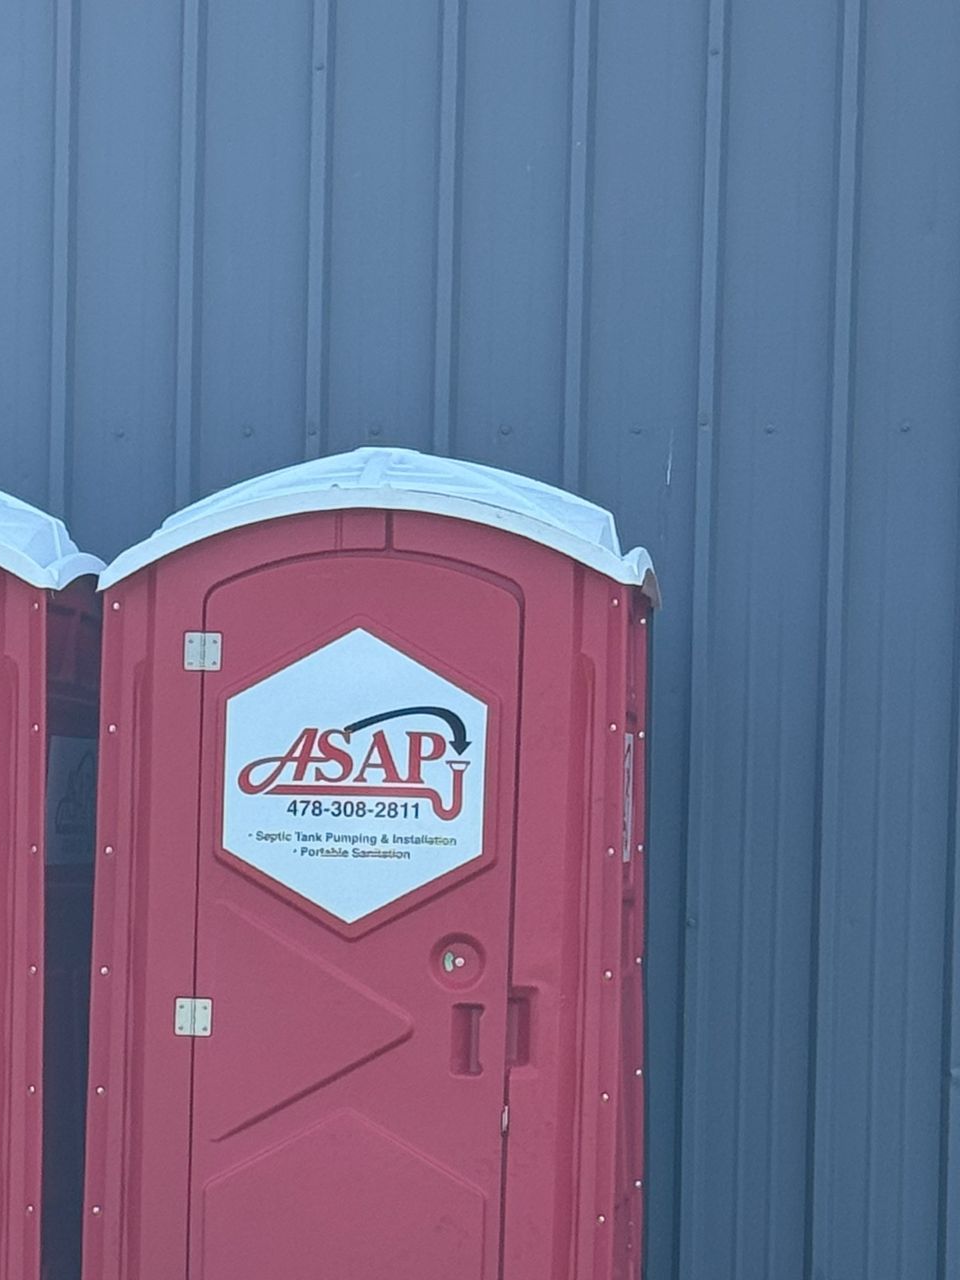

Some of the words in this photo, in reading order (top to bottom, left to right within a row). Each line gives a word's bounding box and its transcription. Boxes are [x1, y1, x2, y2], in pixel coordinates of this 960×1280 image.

[237, 728, 447, 795] ASAP
[286, 800, 420, 820] 478-308-2811
[255, 830, 292, 843] Septic
[294, 831, 323, 843] Tank
[325, 832, 378, 846] Pumping
[380, 834, 390, 845] &
[392, 834, 457, 847] Installation
[300, 847, 349, 859] Portable
[351, 849, 411, 860] Sanitation
